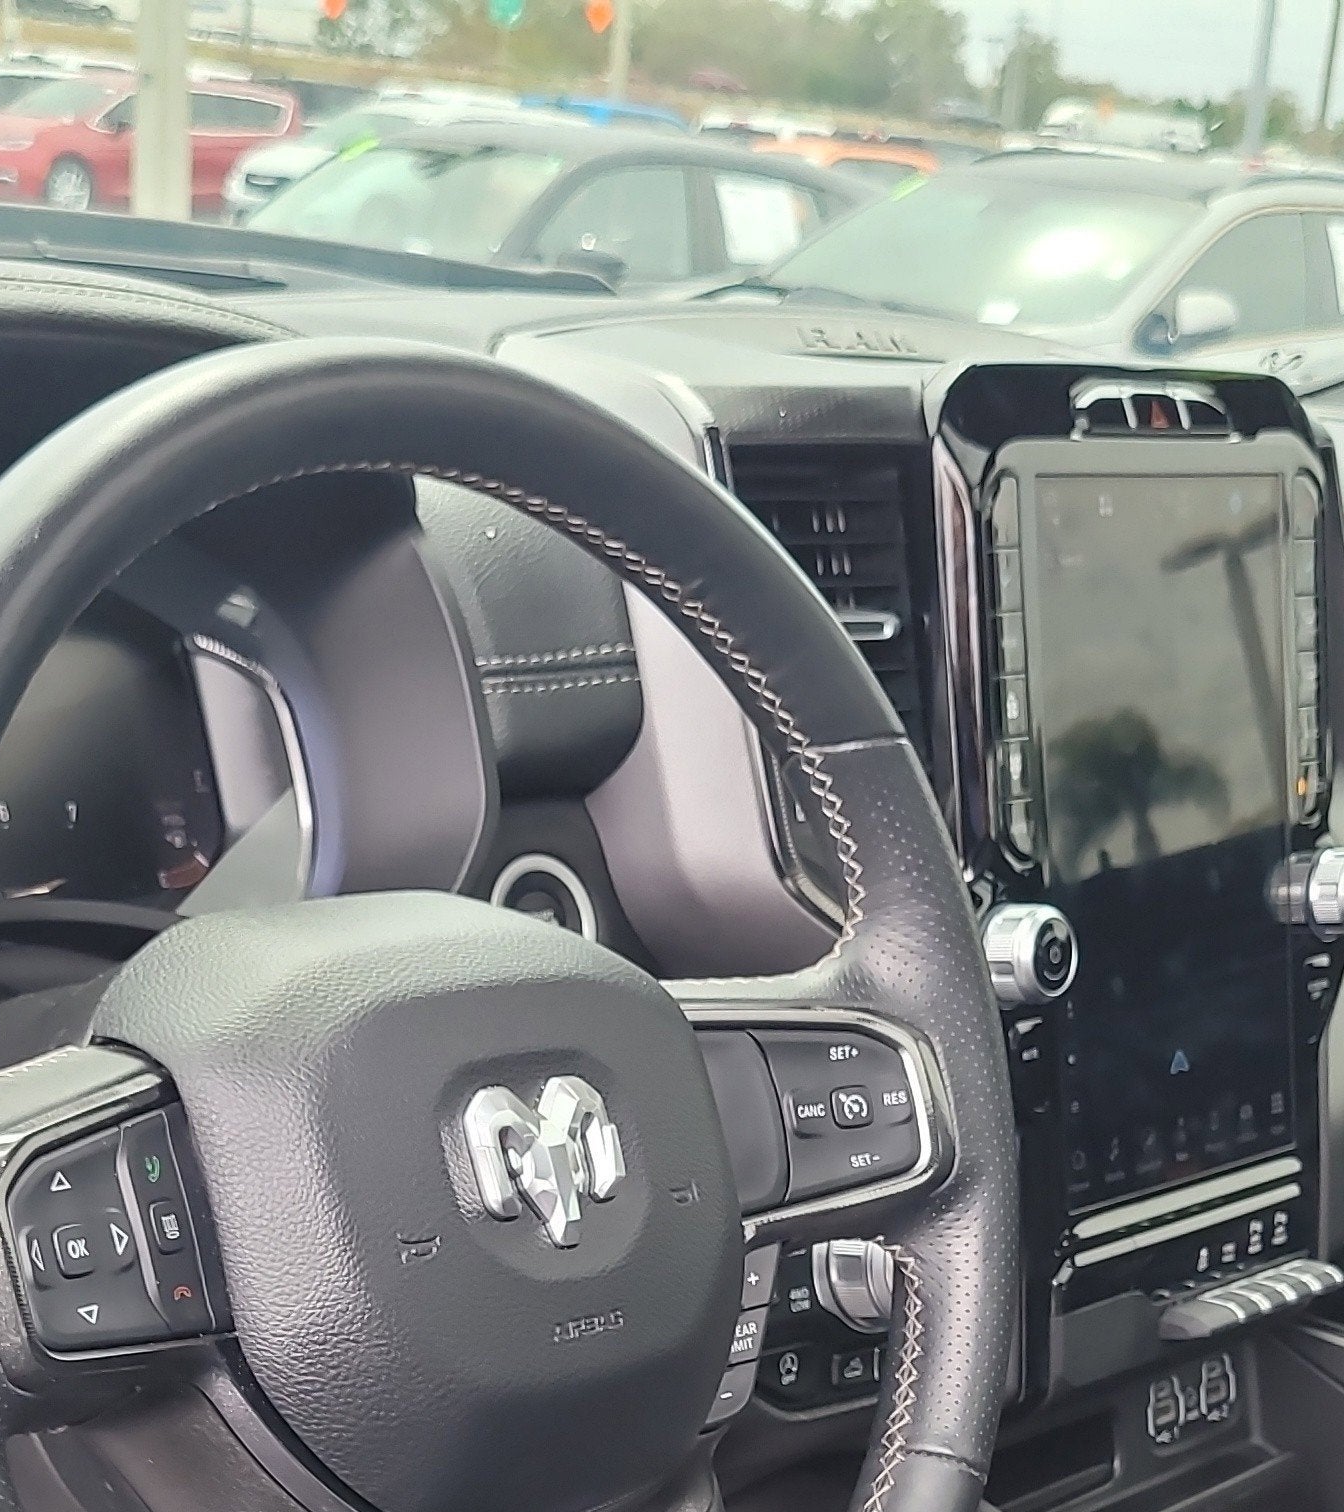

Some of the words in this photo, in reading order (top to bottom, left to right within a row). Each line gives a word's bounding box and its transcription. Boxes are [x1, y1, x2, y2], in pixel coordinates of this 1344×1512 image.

[883, 1091, 907, 1106] RES
[797, 1104, 826, 1118] CANC
[67, 1237, 90, 1259] OK
[735, 1322, 758, 1338] EAR
